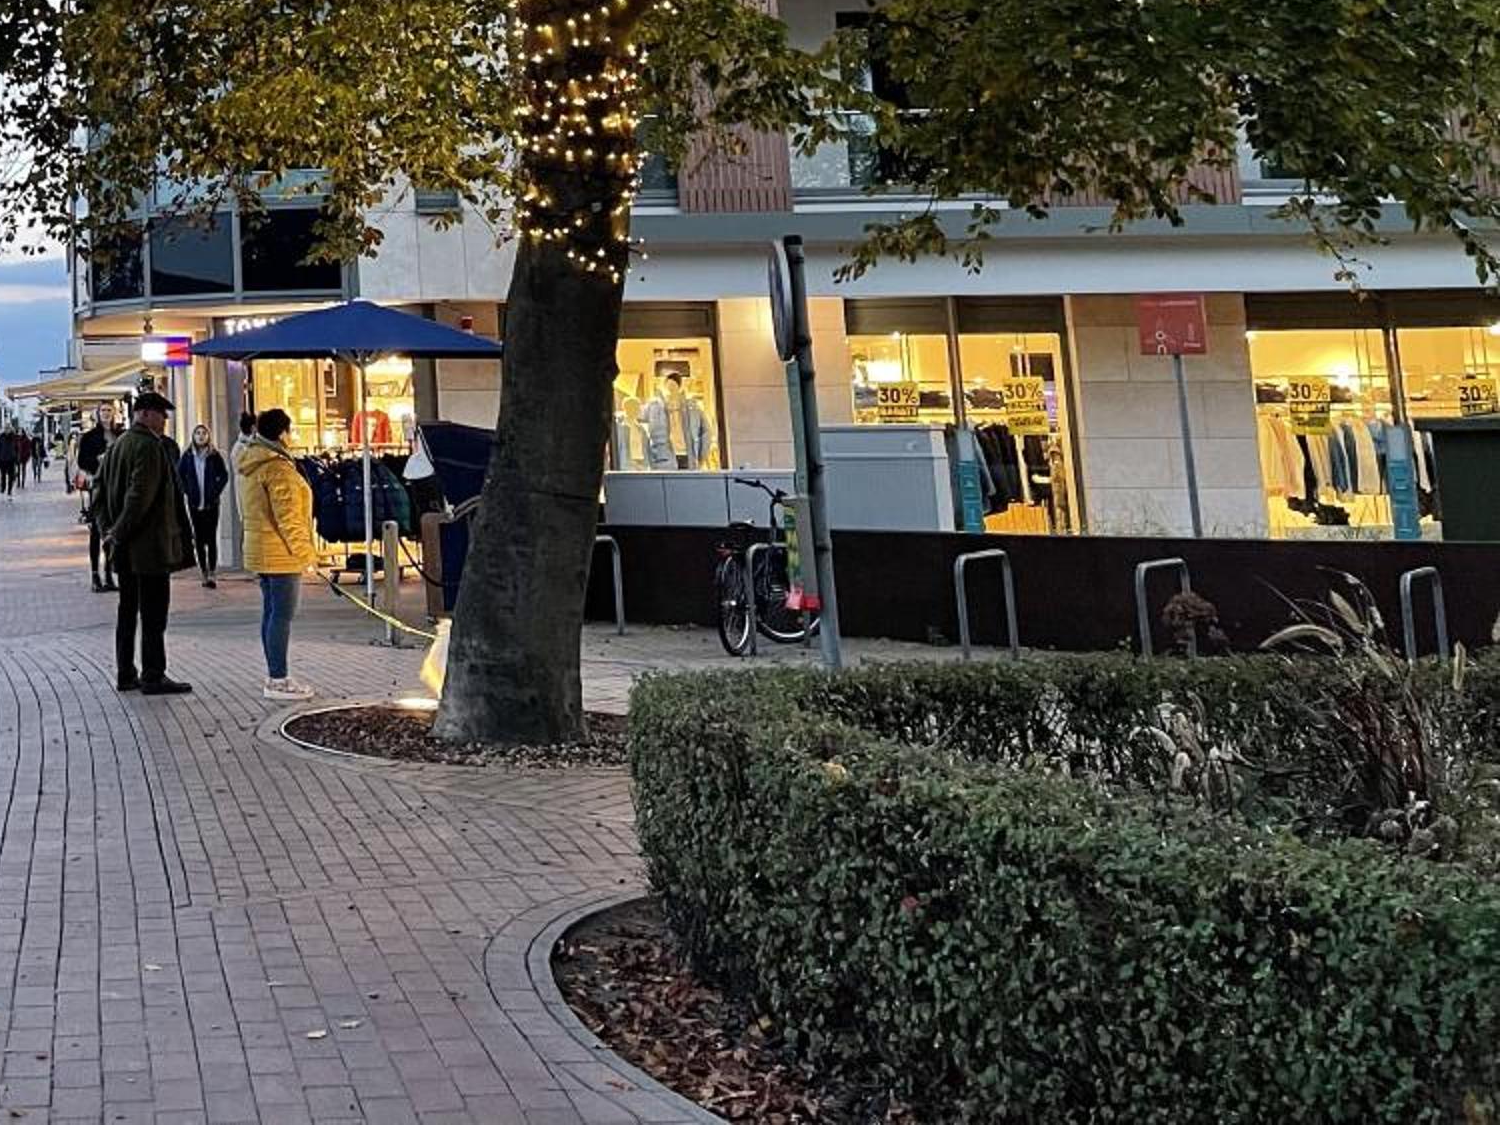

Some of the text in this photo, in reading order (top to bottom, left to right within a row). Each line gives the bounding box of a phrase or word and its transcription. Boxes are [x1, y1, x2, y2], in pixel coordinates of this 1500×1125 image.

[879, 386, 918, 404] 30%
[1003, 382, 1043, 400] 30%
[1289, 382, 1329, 400] 30%
[1458, 385, 1498, 402] 30%
